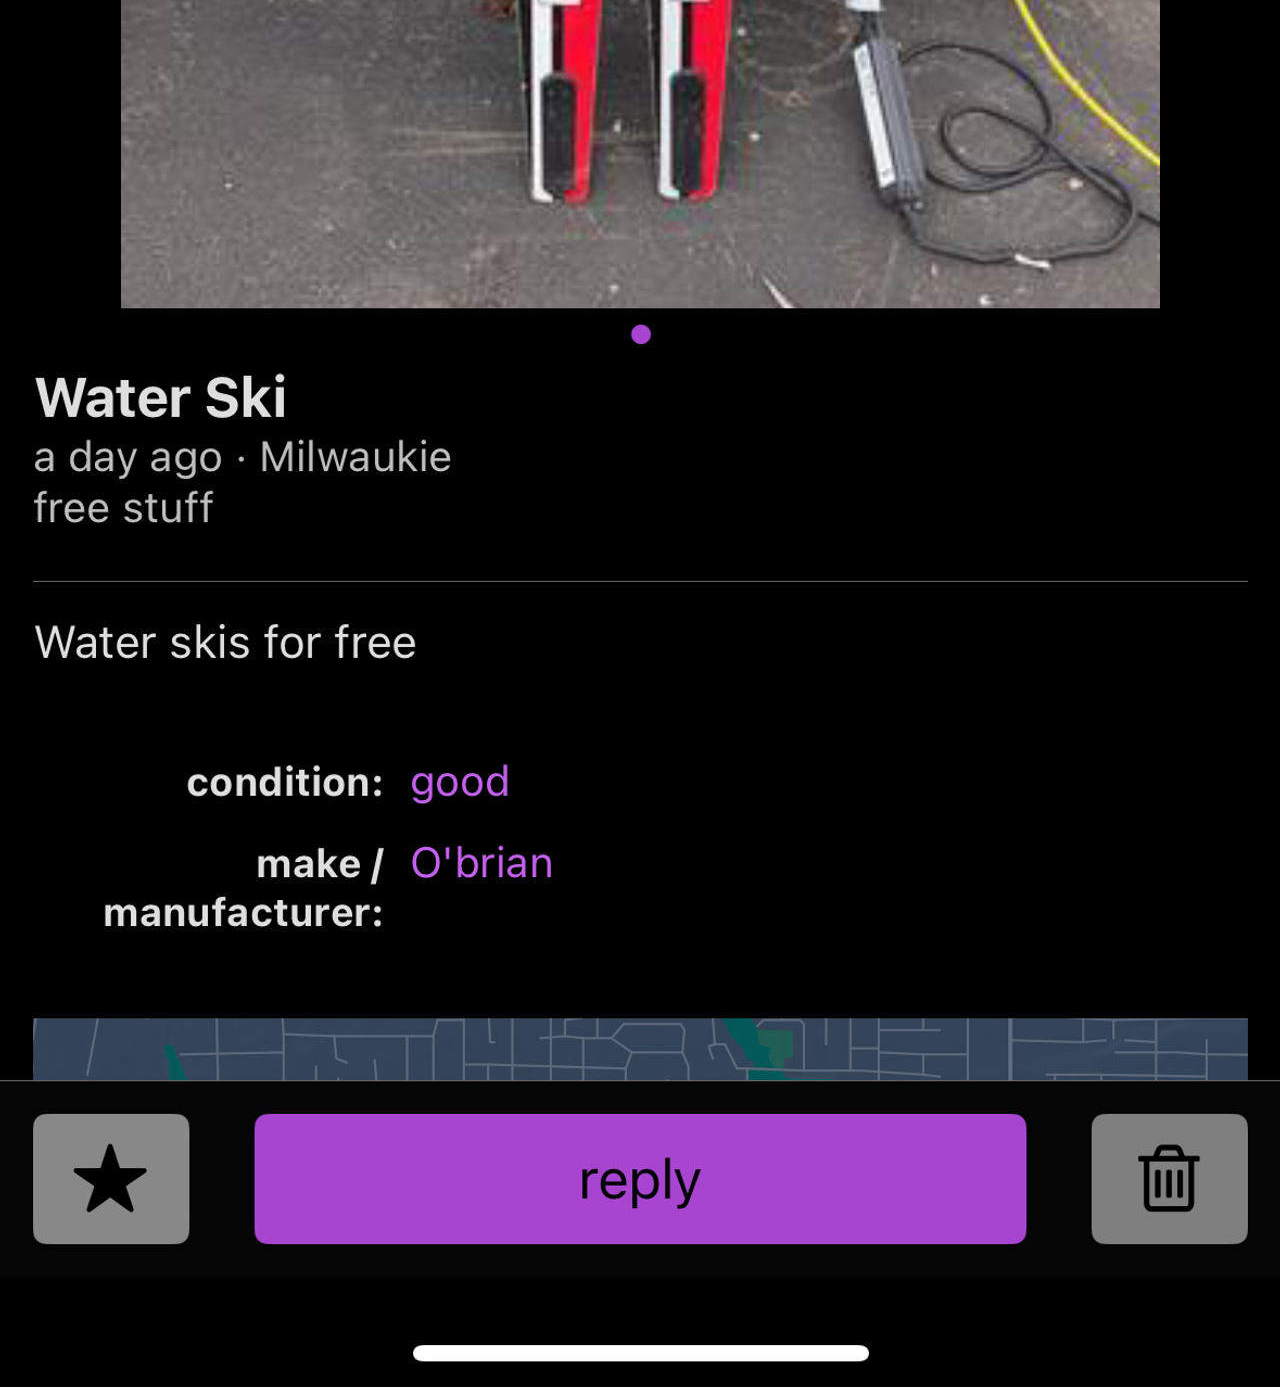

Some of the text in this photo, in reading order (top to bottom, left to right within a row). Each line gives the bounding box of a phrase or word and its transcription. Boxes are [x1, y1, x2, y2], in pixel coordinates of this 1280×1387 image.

[35, 373, 286, 419] Water Ski
[34, 447, 55, 473] a
[69, 439, 138, 481] day
[150, 447, 222, 481] ago
[261, 439, 451, 473] Milwaukie
[33, 490, 214, 524] free stuff
[34, 623, 416, 660] Water skis for free
[187, 764, 383, 797] condition:
[411, 763, 510, 805] good
[257, 847, 385, 885] make /
[411, 844, 553, 879] O'brian
[104, 896, 383, 928] manufacturer:
[581, 1157, 701, 1210] reply
